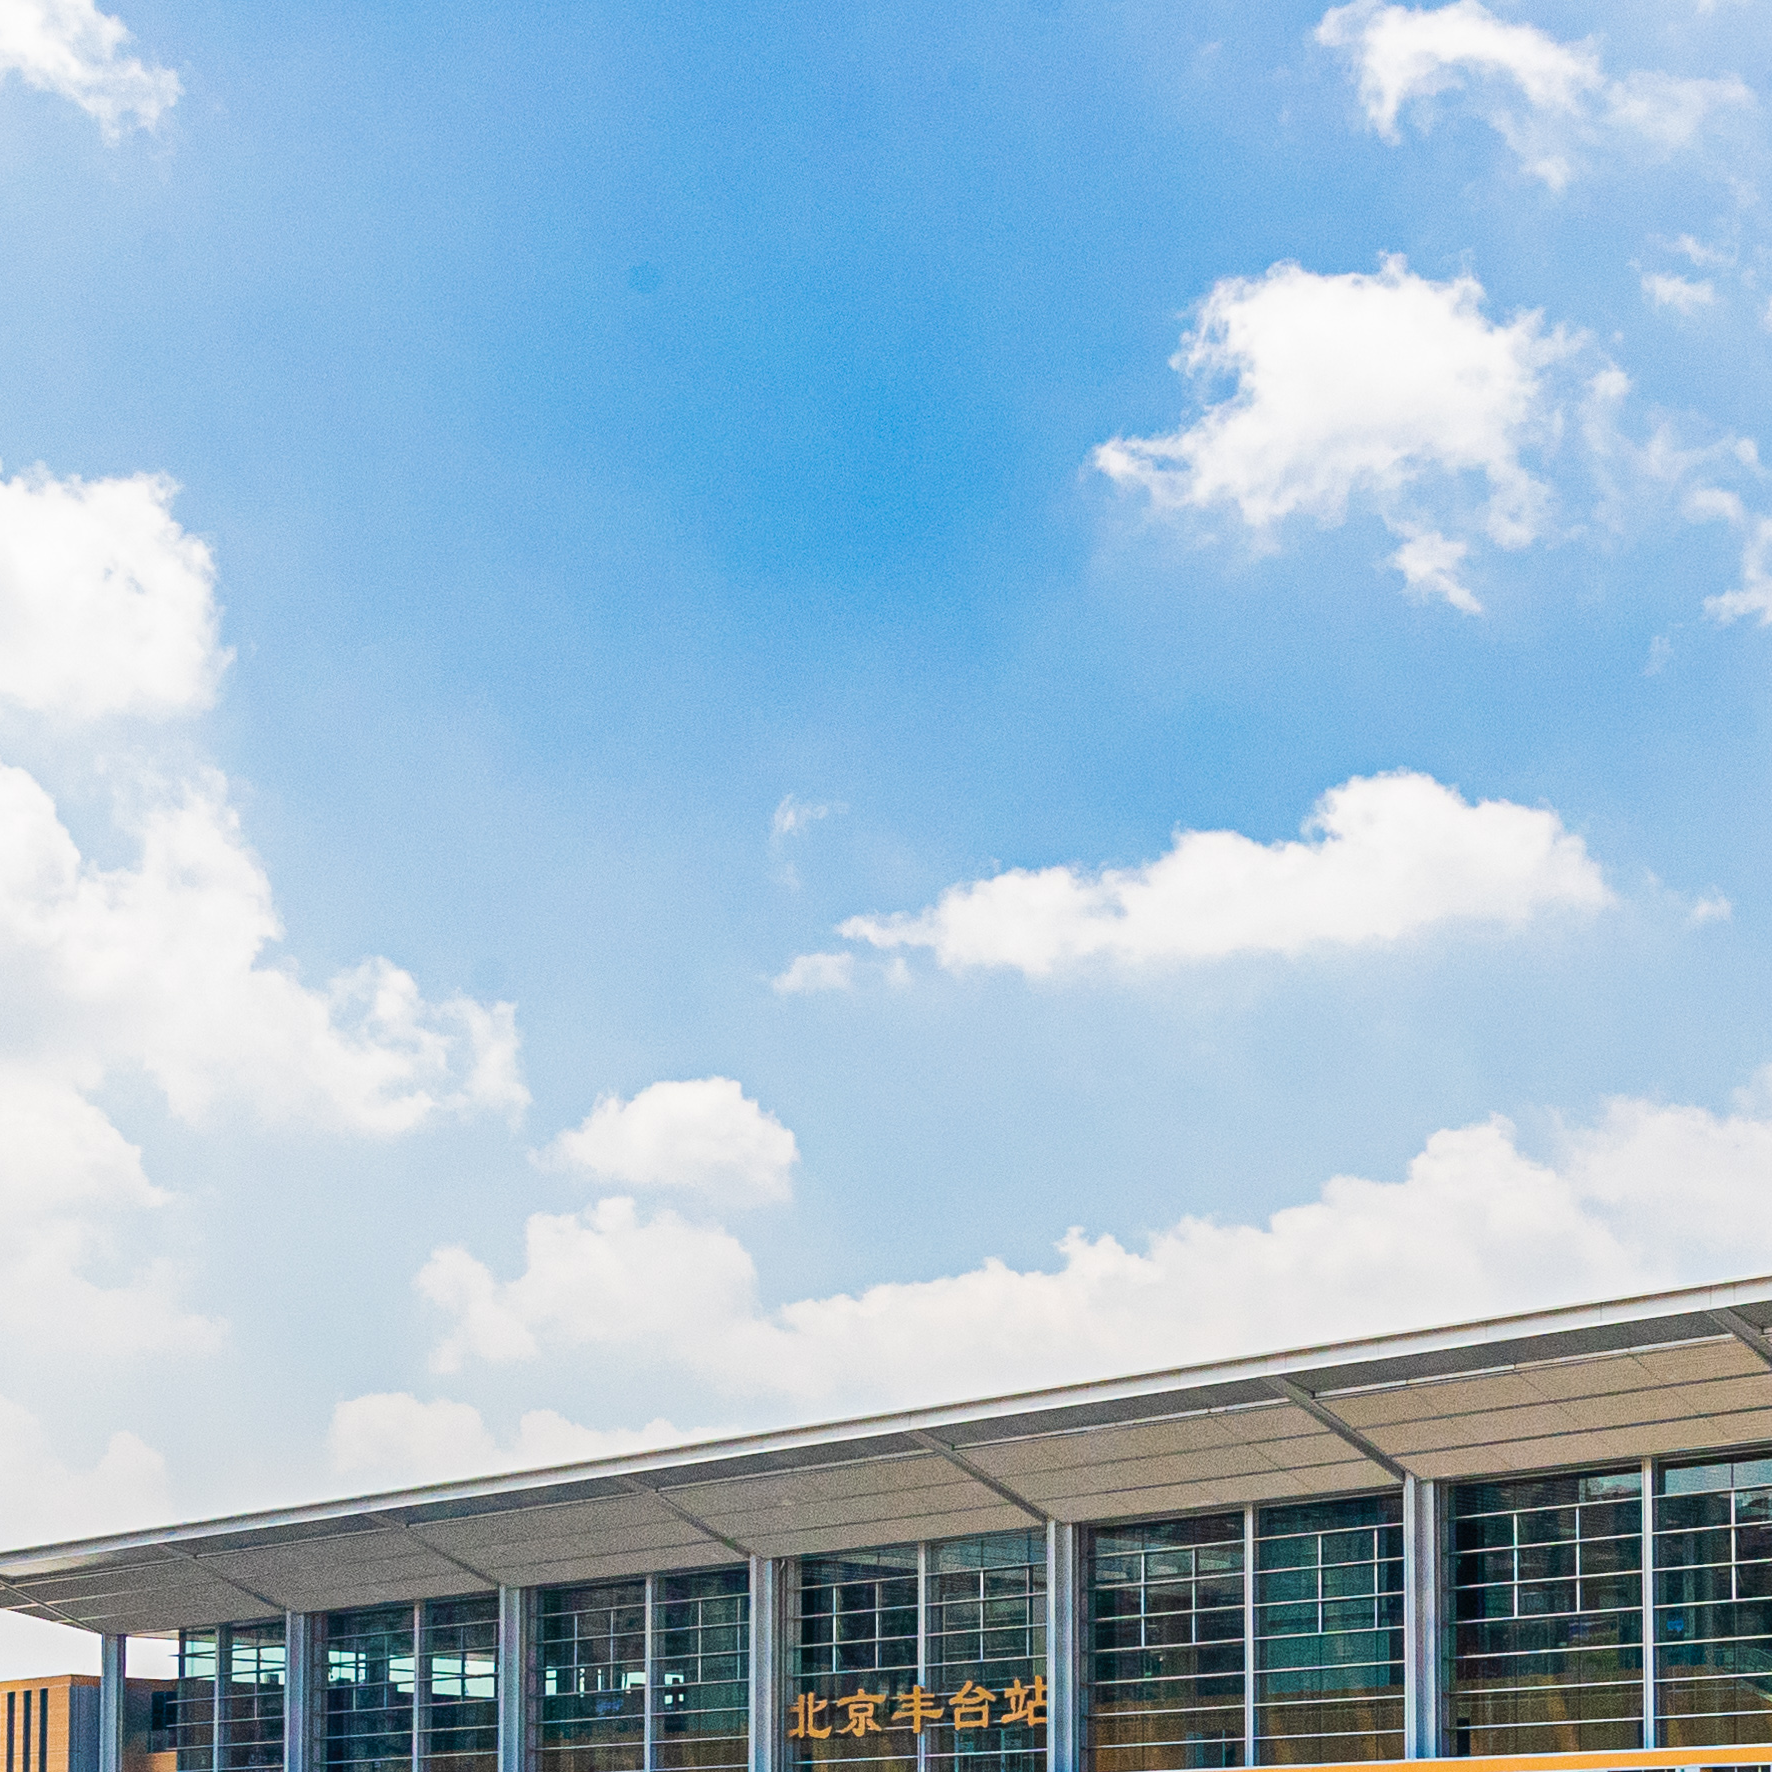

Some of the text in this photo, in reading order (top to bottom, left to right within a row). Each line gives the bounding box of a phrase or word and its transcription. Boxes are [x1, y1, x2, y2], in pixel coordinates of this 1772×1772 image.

[788, 1675, 1047, 1739] 北京丰台站
